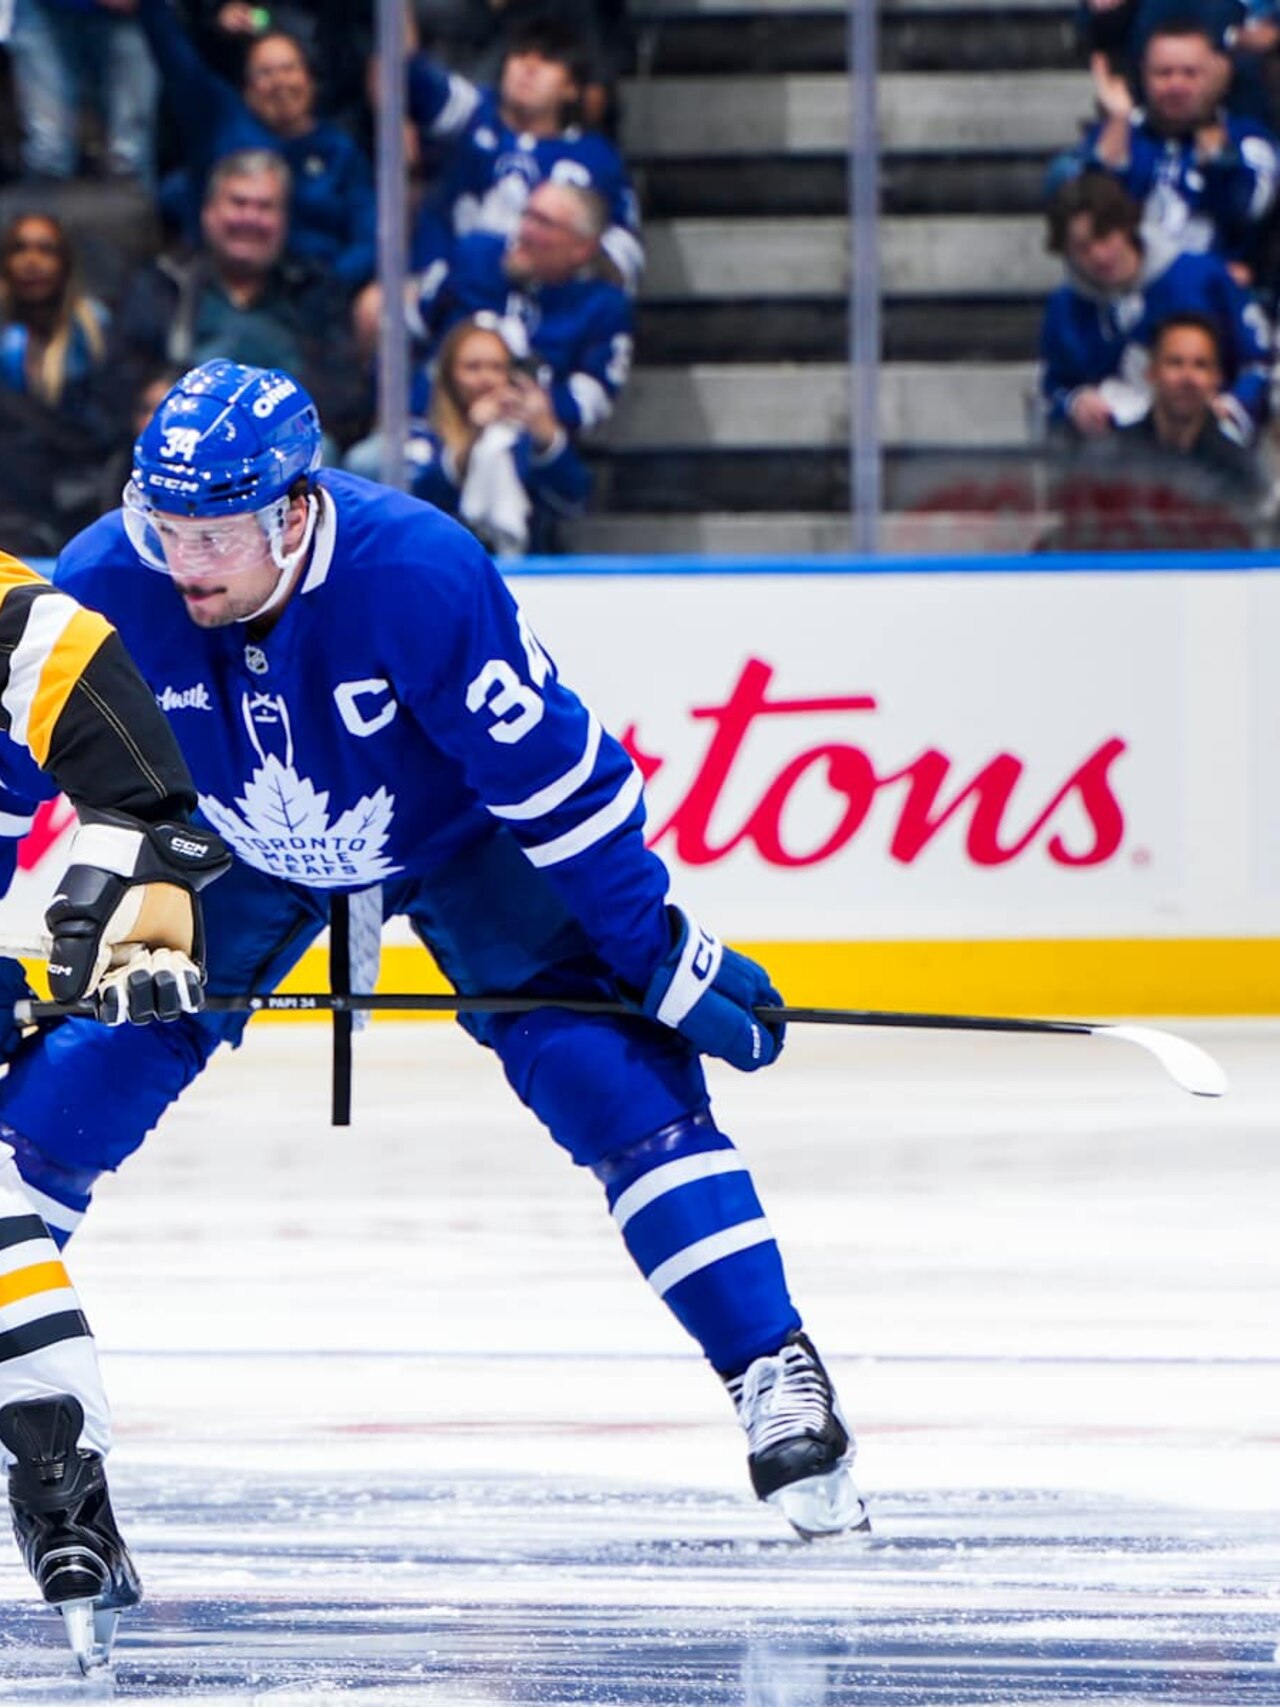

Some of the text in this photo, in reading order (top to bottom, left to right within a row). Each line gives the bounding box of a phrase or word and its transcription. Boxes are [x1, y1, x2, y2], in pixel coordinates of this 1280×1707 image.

[159, 427, 203, 462] 34
[149, 474, 200, 493] CCM
[333, 678, 398, 738] C
[171, 837, 209, 855] CCM
[235, 836, 367, 851] TORONTO
[262, 851, 353, 865] MAPLE
[268, 864, 358, 876] LEAFS
